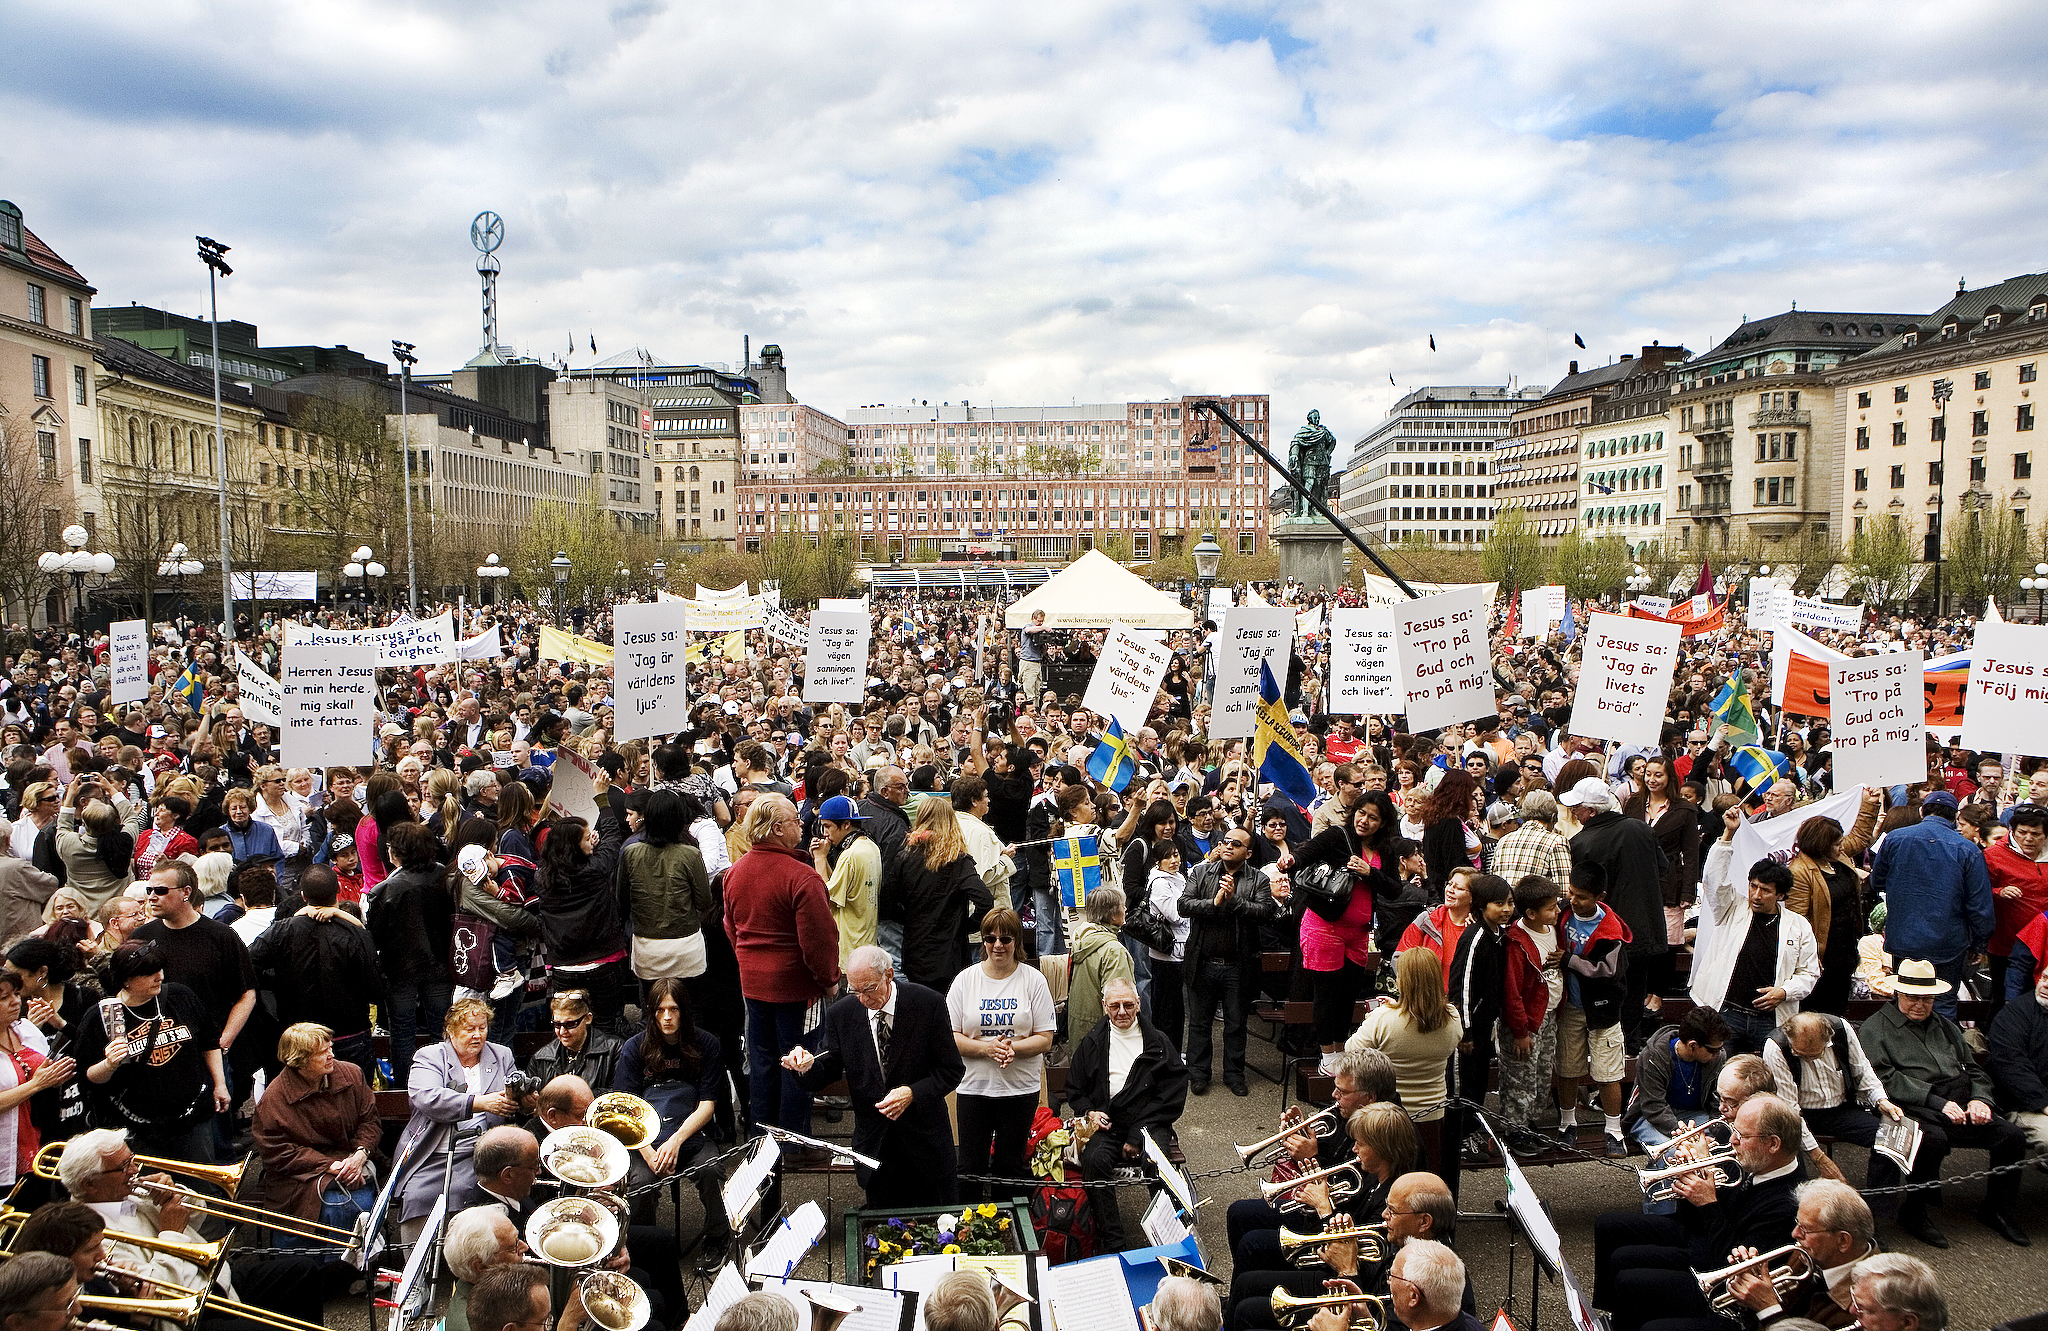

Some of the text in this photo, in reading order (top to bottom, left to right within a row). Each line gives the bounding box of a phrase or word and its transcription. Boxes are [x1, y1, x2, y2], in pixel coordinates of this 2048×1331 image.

[1794, 600, 1817, 610] Jesus
[1403, 609, 1473, 636] Jesus sa:
[1792, 610, 1831, 623] världens
[311, 633, 347, 645] Jesus
[408, 626, 422, 636] är
[622, 629, 678, 646] Jesus sa:
[779, 628, 796, 641] och
[818, 626, 858, 636] Jesus sa:
[1235, 627, 1281, 640] Jesus sa:
[1344, 628, 1392, 638] Jesus sa:
[116, 634, 130, 642] Jesus
[389, 636, 410, 649] går
[418, 632, 441, 643] och
[822, 638, 854, 649] "Jag är
[1412, 629, 1471, 655] "Tro på
[1597, 634, 1668, 655] Jesus sa:
[126, 643, 135, 651] och
[389, 645, 444, 660] evighet.
[1116, 632, 1165, 664] Jesus sa:
[1238, 646, 1275, 660] "Jag är
[1349, 643, 1388, 655] "Jag är
[629, 652, 674, 668] "Jag är
[827, 652, 851, 662] vägen
[1118, 650, 1155, 677] "Jag är
[816, 665, 856, 675] sanningen
[1356, 659, 1384, 670] vägen
[1416, 653, 1475, 677] Gud och
[1601, 655, 1658, 676] "Jag är
[1983, 658, 2048, 677] Jesus s
[237, 662, 266, 689] Jesus
[288, 666, 373, 678] Herren Jesus
[1243, 665, 1261, 678] väg
[1837, 663, 1907, 685] Jesus sa:
[627, 673, 676, 690] världens
[813, 677, 828, 685] och
[1109, 665, 1151, 693] världens
[1344, 674, 1392, 685] sanningen
[283, 684, 298, 694] är
[303, 683, 324, 694] min
[1230, 682, 1260, 695] sannin
[1341, 686, 1358, 696] och
[1407, 689, 1430, 702] tro
[1436, 679, 1453, 699] på
[1605, 677, 1645, 695] livets
[1845, 687, 1878, 703] "Tro
[1885, 682, 1901, 701] på
[1976, 679, 2017, 701] "Följ
[300, 699, 354, 712] mig skall
[1225, 700, 1256, 713] och liv
[290, 716, 362, 727] inte fattas.
[1845, 706, 1904, 726] Gud och
[1833, 735, 1857, 749] tro
[1862, 728, 1880, 748] på
[979, 998, 1018, 1010] JESUS
[981, 1013, 1015, 1026] IS MY
